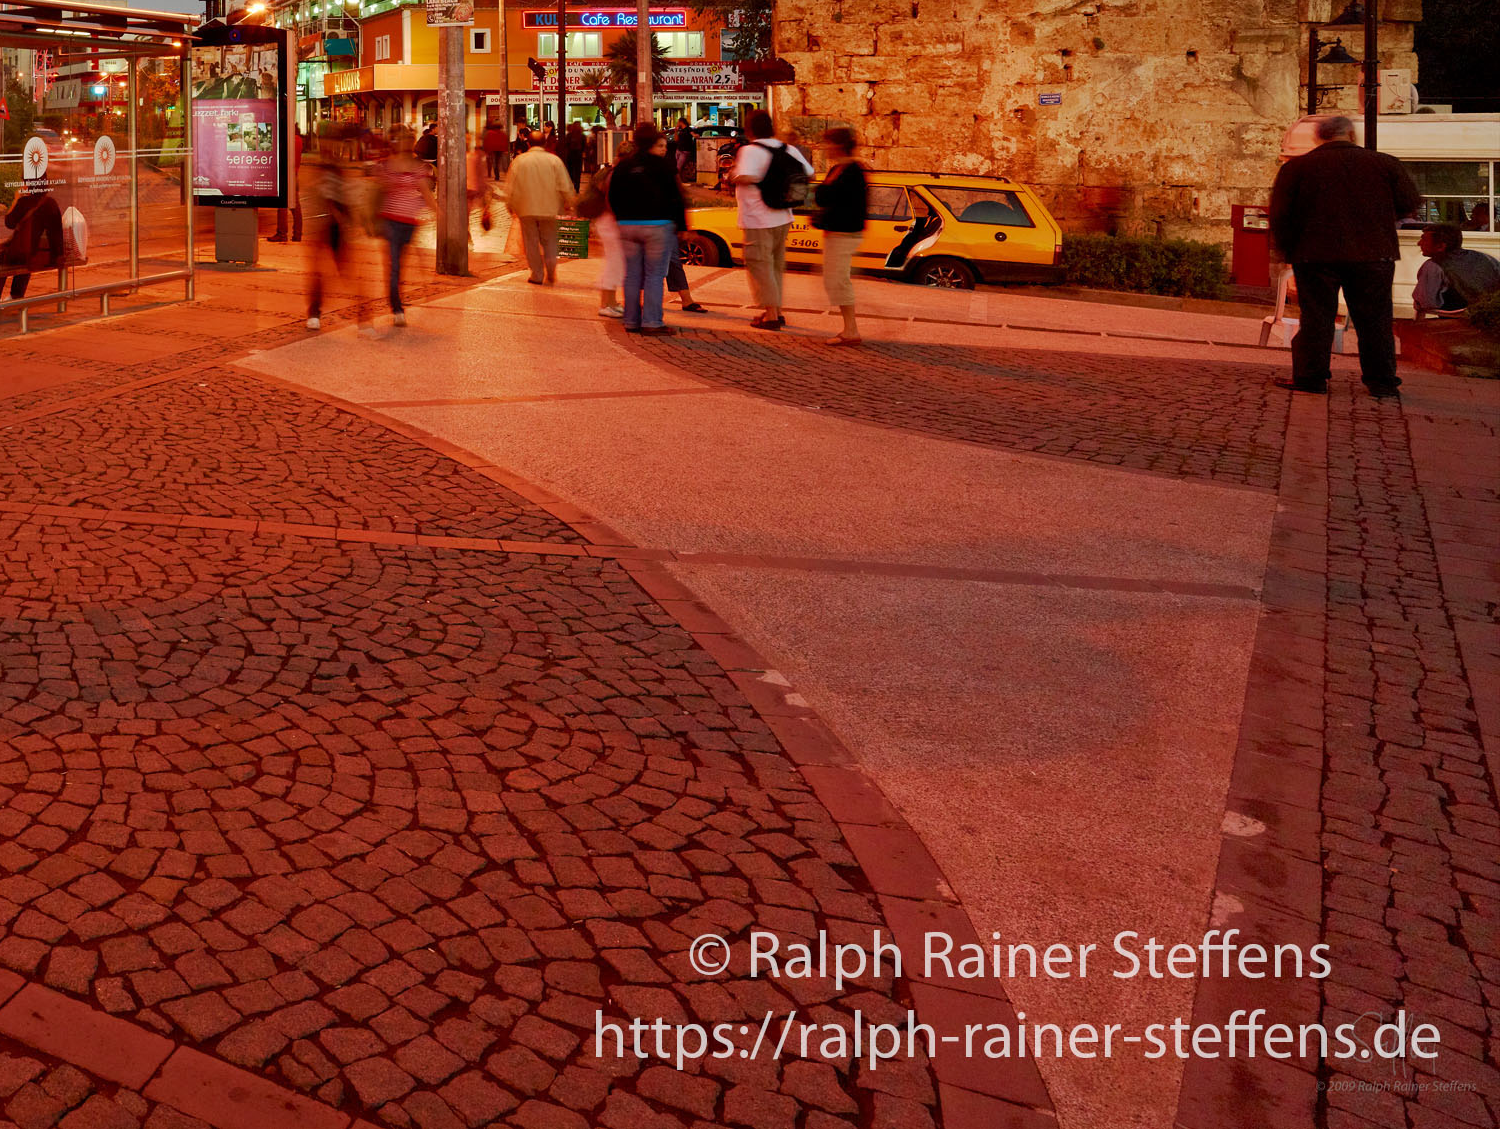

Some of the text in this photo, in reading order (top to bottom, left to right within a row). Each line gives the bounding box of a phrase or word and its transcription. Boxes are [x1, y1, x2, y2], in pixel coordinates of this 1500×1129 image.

[536, 13, 684, 26] KUL Cafe Resaurant
[551, 76, 580, 84] DNER
